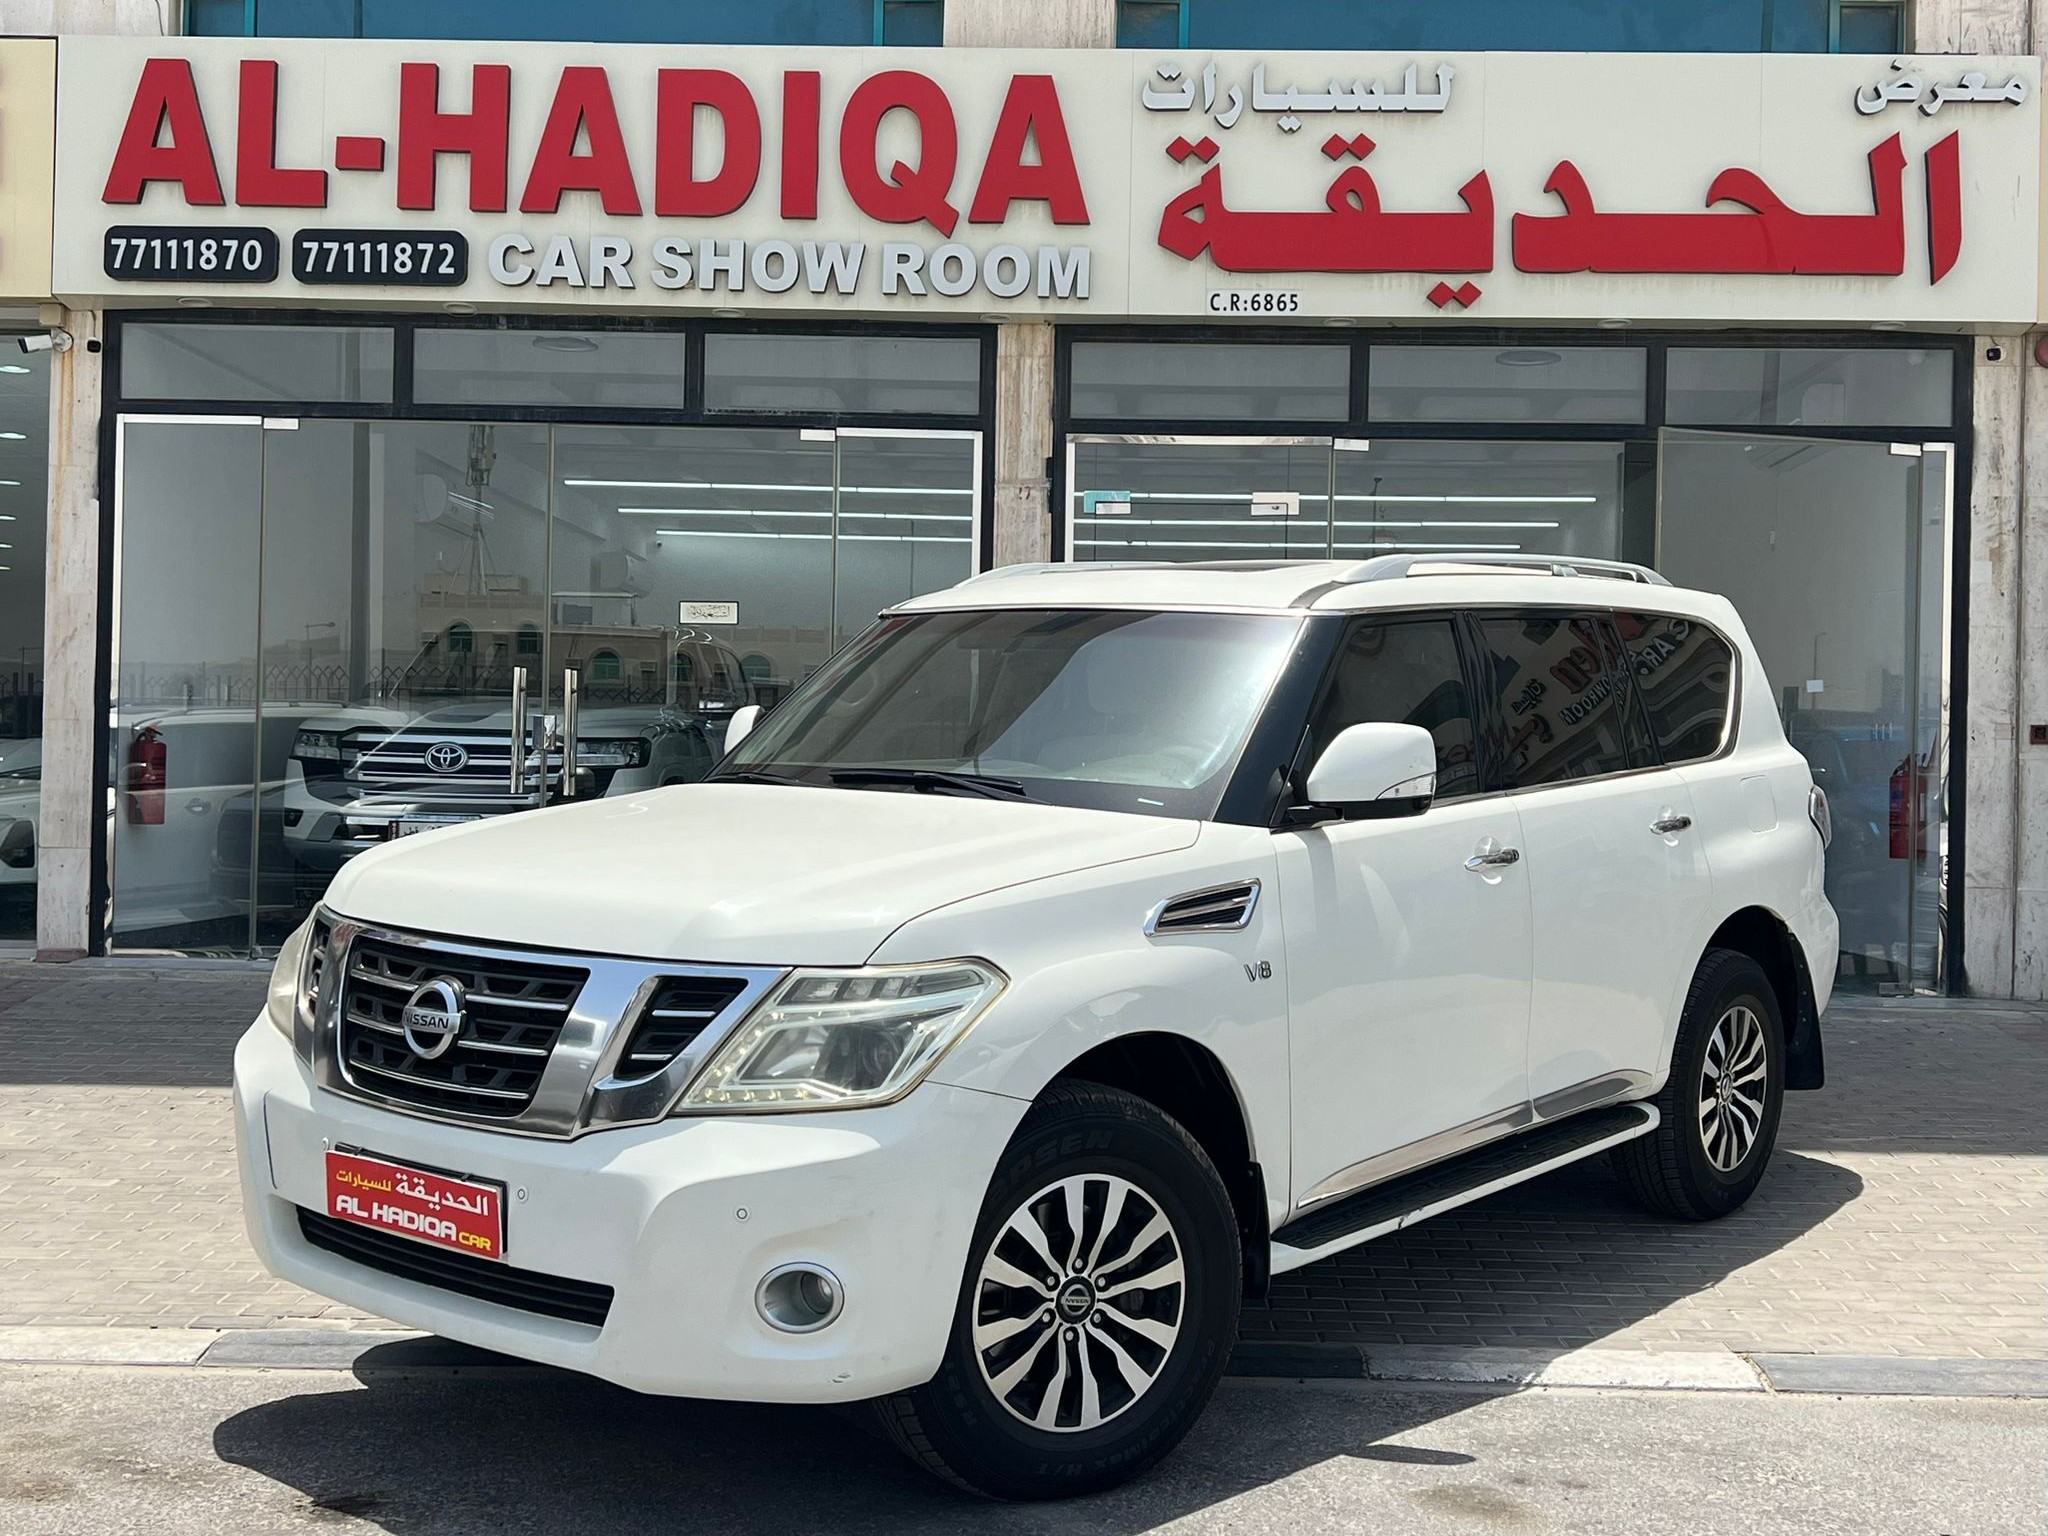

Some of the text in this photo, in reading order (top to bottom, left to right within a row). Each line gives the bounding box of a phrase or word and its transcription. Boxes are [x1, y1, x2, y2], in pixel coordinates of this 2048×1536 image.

[1142, 60, 1456, 133] للسيارات
[1853, 58, 2029, 117] معرض
[101, 57, 1091, 239] AL-HADIQA
[1156, 129, 1963, 311] الحديقة
[110, 237, 264, 272] 77111870
[301, 241, 456, 276] 77111872
[487, 233, 1091, 300] CAR SHOW ROOM
[1209, 293, 1299, 312] C.R:6865
[1243, 960, 1272, 982] V8
[404, 1010, 449, 1029] NISSAN
[335, 1169, 489, 1217] للسيارات الحديقة
[336, 1194, 369, 1219] AL
[458, 1231, 492, 1251] CAR
